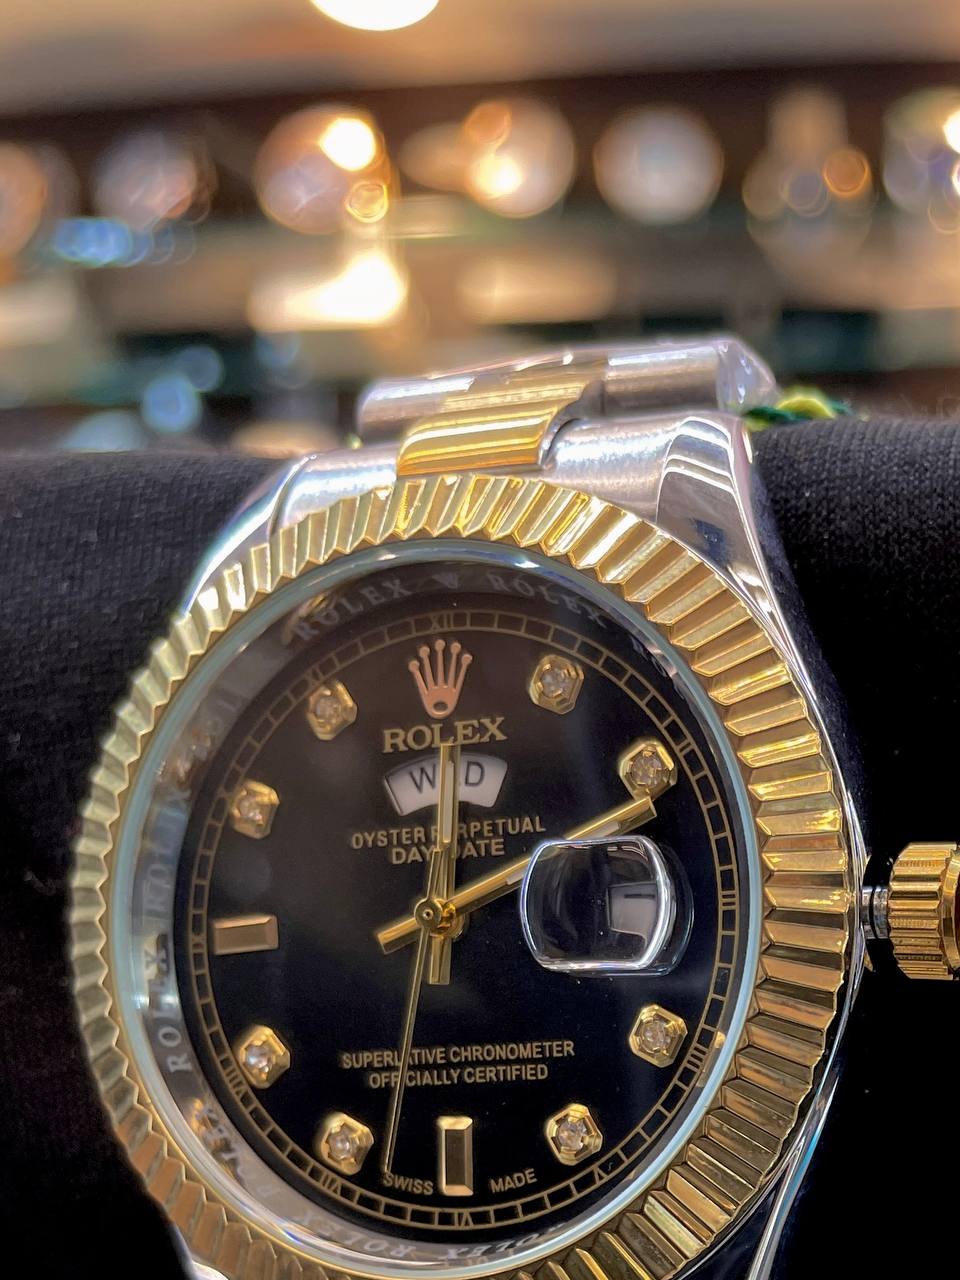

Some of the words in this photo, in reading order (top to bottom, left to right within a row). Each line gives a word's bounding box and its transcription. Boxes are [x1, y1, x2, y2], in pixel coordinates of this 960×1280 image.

[382, 716, 508, 754] ROLEX
[409, 761, 486, 794] WD
[352, 827, 426, 849] OYSTER
[431, 815, 547, 842] PRPETUAL
[392, 838, 505, 865] DAYATE
[449, 1040, 576, 1063] CHRONOMETER
[368, 1068, 461, 1089] OFFCIALLY
[463, 1063, 549, 1084] CERTIFIED
[383, 1172, 434, 1196] SWISS
[489, 1168, 538, 1193] MADE
